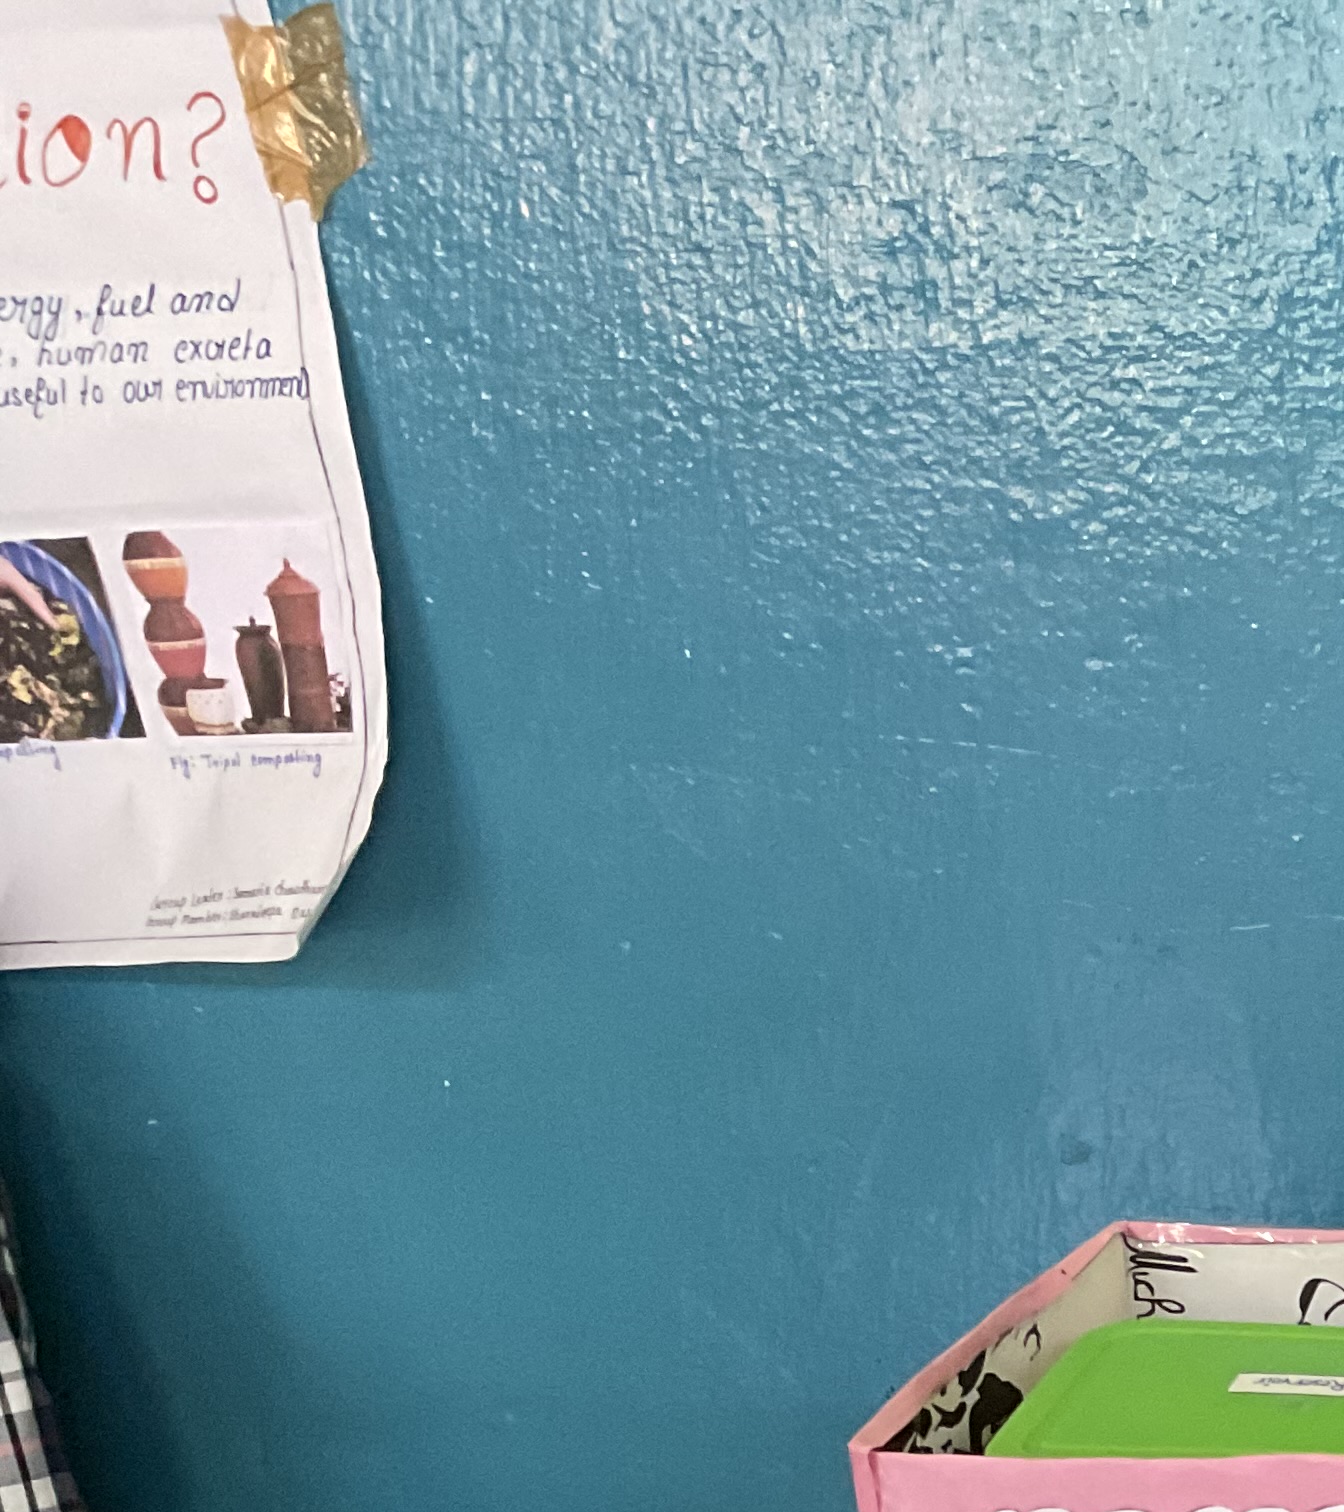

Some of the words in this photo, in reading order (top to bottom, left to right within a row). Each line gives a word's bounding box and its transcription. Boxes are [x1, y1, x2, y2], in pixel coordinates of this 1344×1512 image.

[0, 92, 226, 204] ion?
[92, 283, 155, 335] fuel
[170, 277, 241, 316] and
[37, 340, 149, 367] human
[80, 375, 104, 407] to
[123, 379, 162, 404] our
